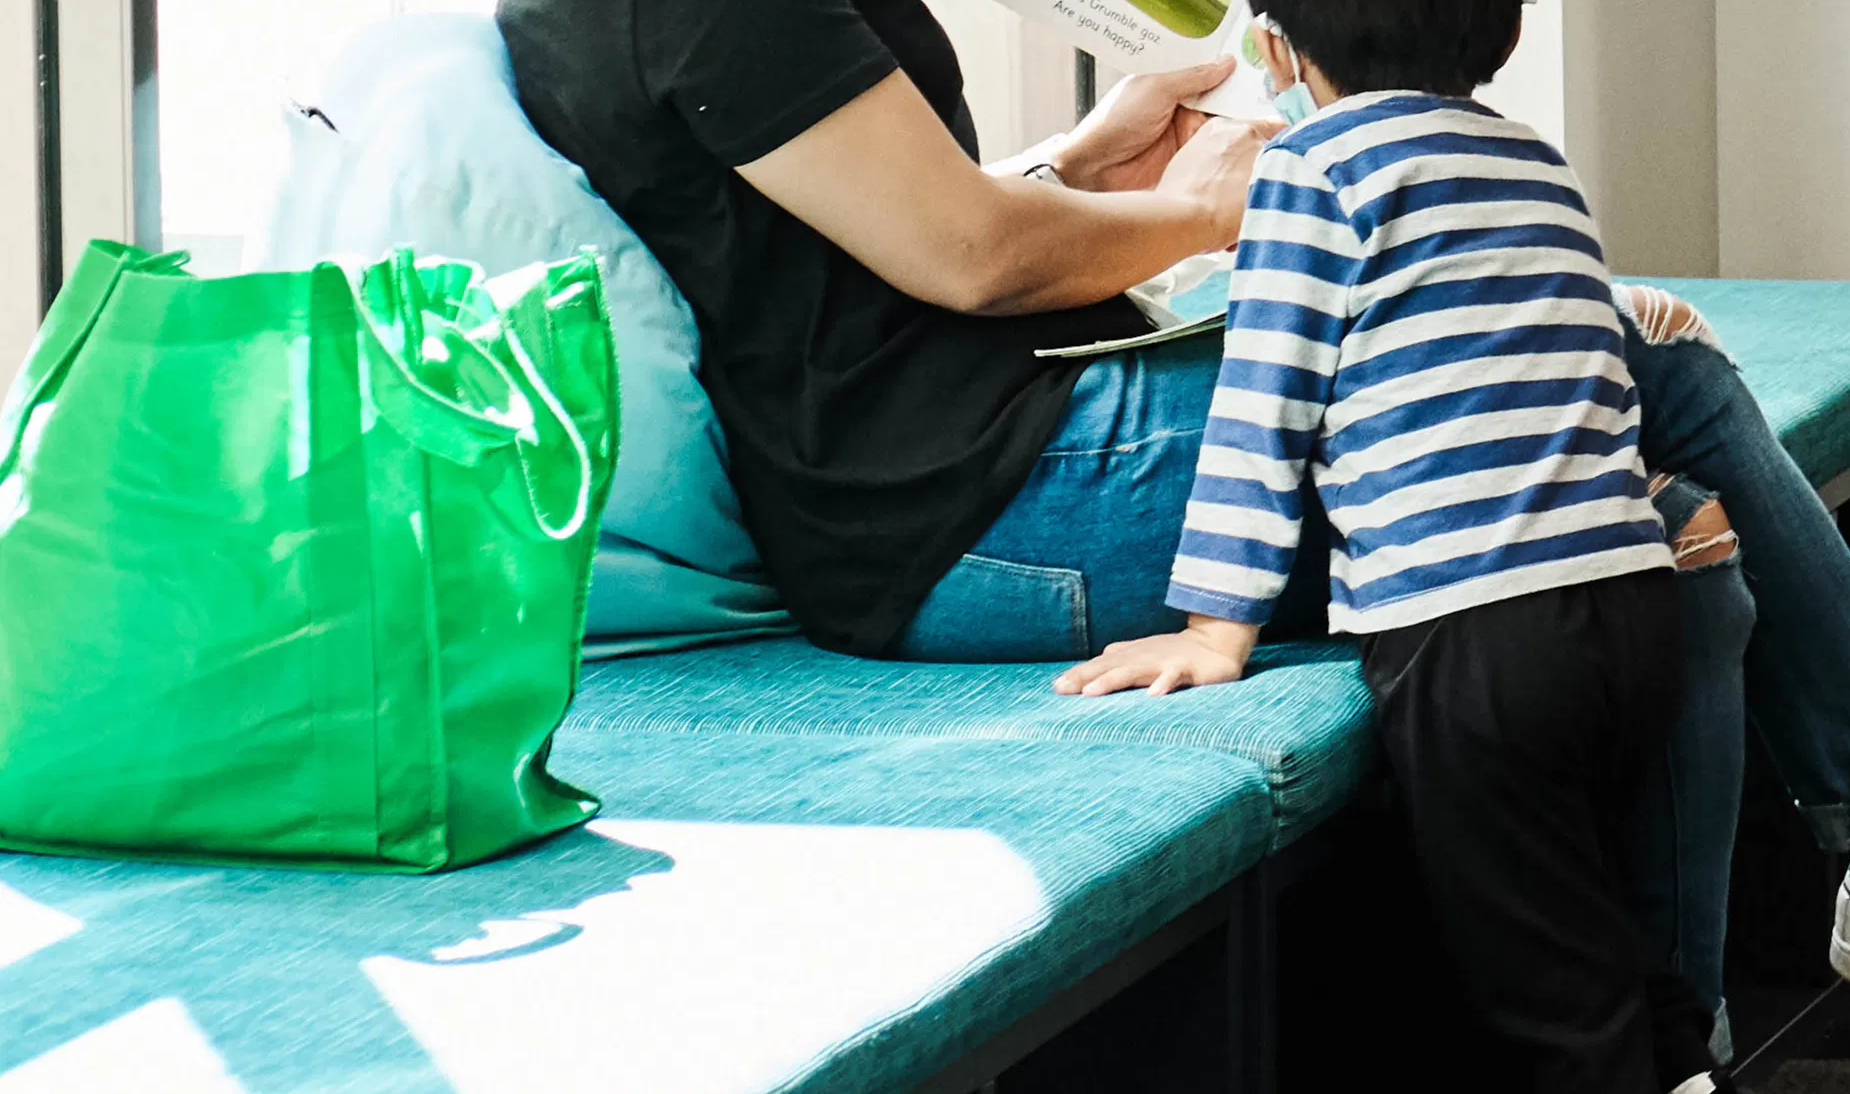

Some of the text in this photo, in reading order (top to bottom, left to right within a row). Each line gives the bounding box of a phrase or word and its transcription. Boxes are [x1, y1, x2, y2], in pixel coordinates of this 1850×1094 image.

[1052, 0, 1145, 55] Are you happy?
